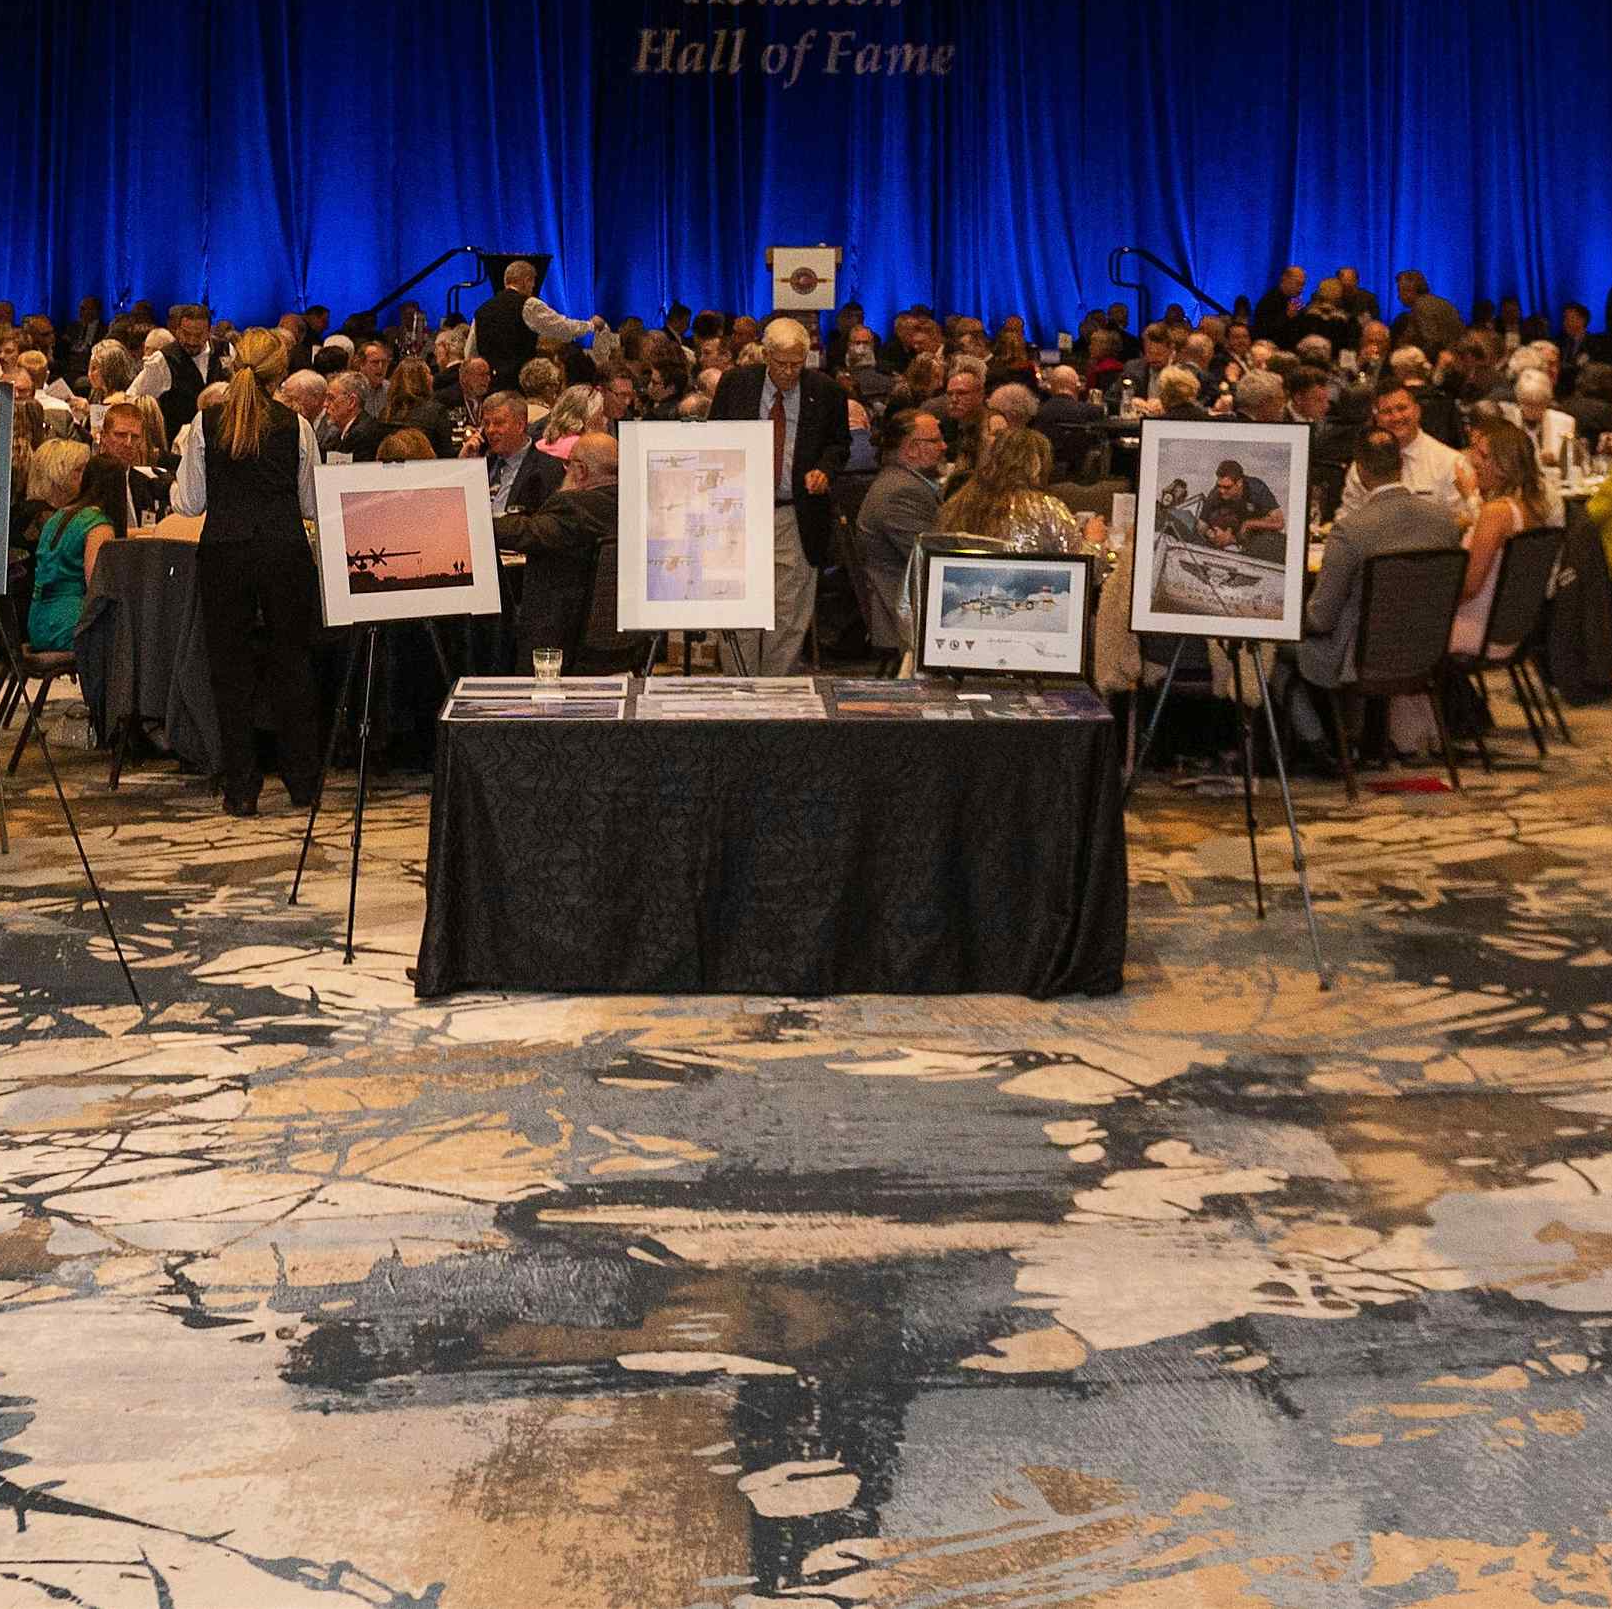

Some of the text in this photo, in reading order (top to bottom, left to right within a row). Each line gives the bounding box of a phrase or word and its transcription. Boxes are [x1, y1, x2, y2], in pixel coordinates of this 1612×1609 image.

[632, 27, 956, 89] Hall of Fame
